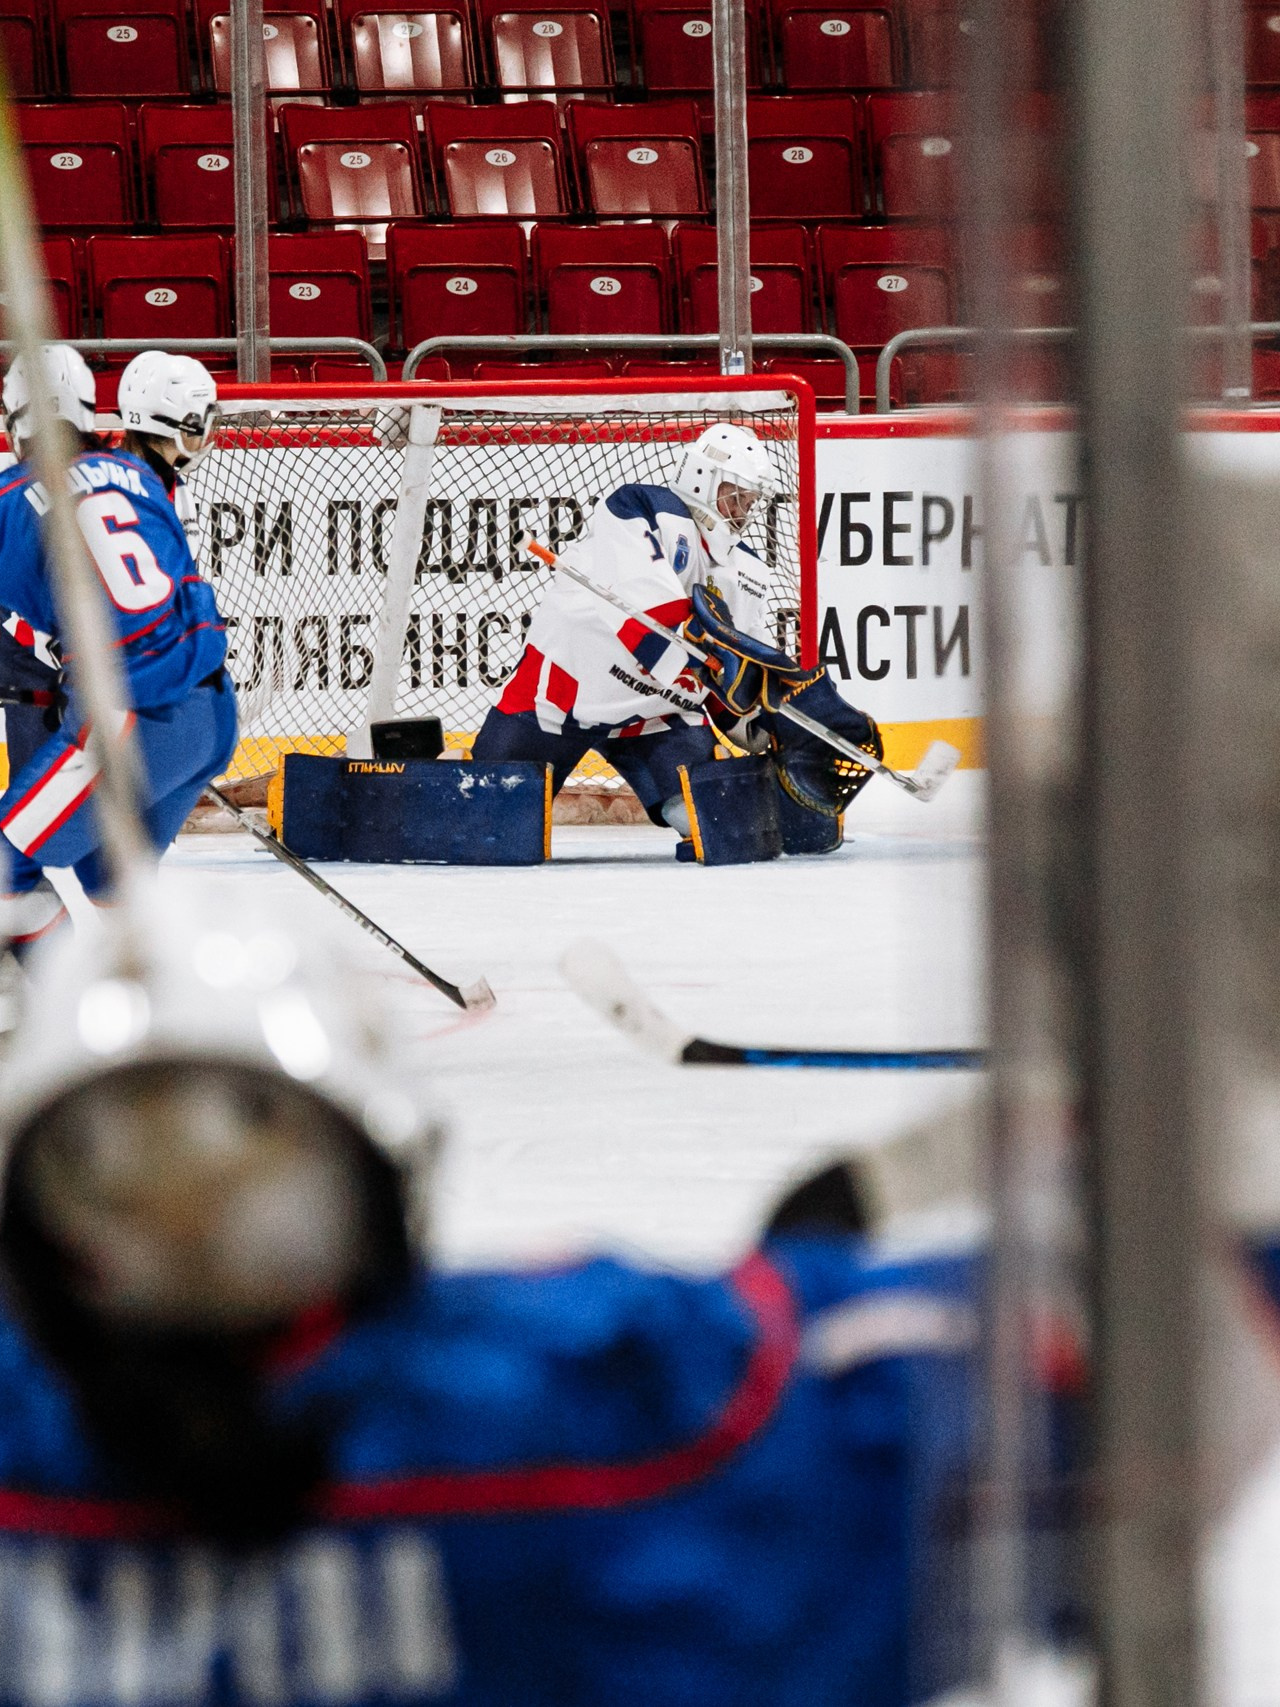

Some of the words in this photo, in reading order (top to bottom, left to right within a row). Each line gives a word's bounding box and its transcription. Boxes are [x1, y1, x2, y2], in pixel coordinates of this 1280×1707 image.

[128, 411, 141, 425] 23
[77, 490, 175, 614] 6
[195, 500, 293, 577] РИ
[327, 495, 601, 585] ПОДДЕР
